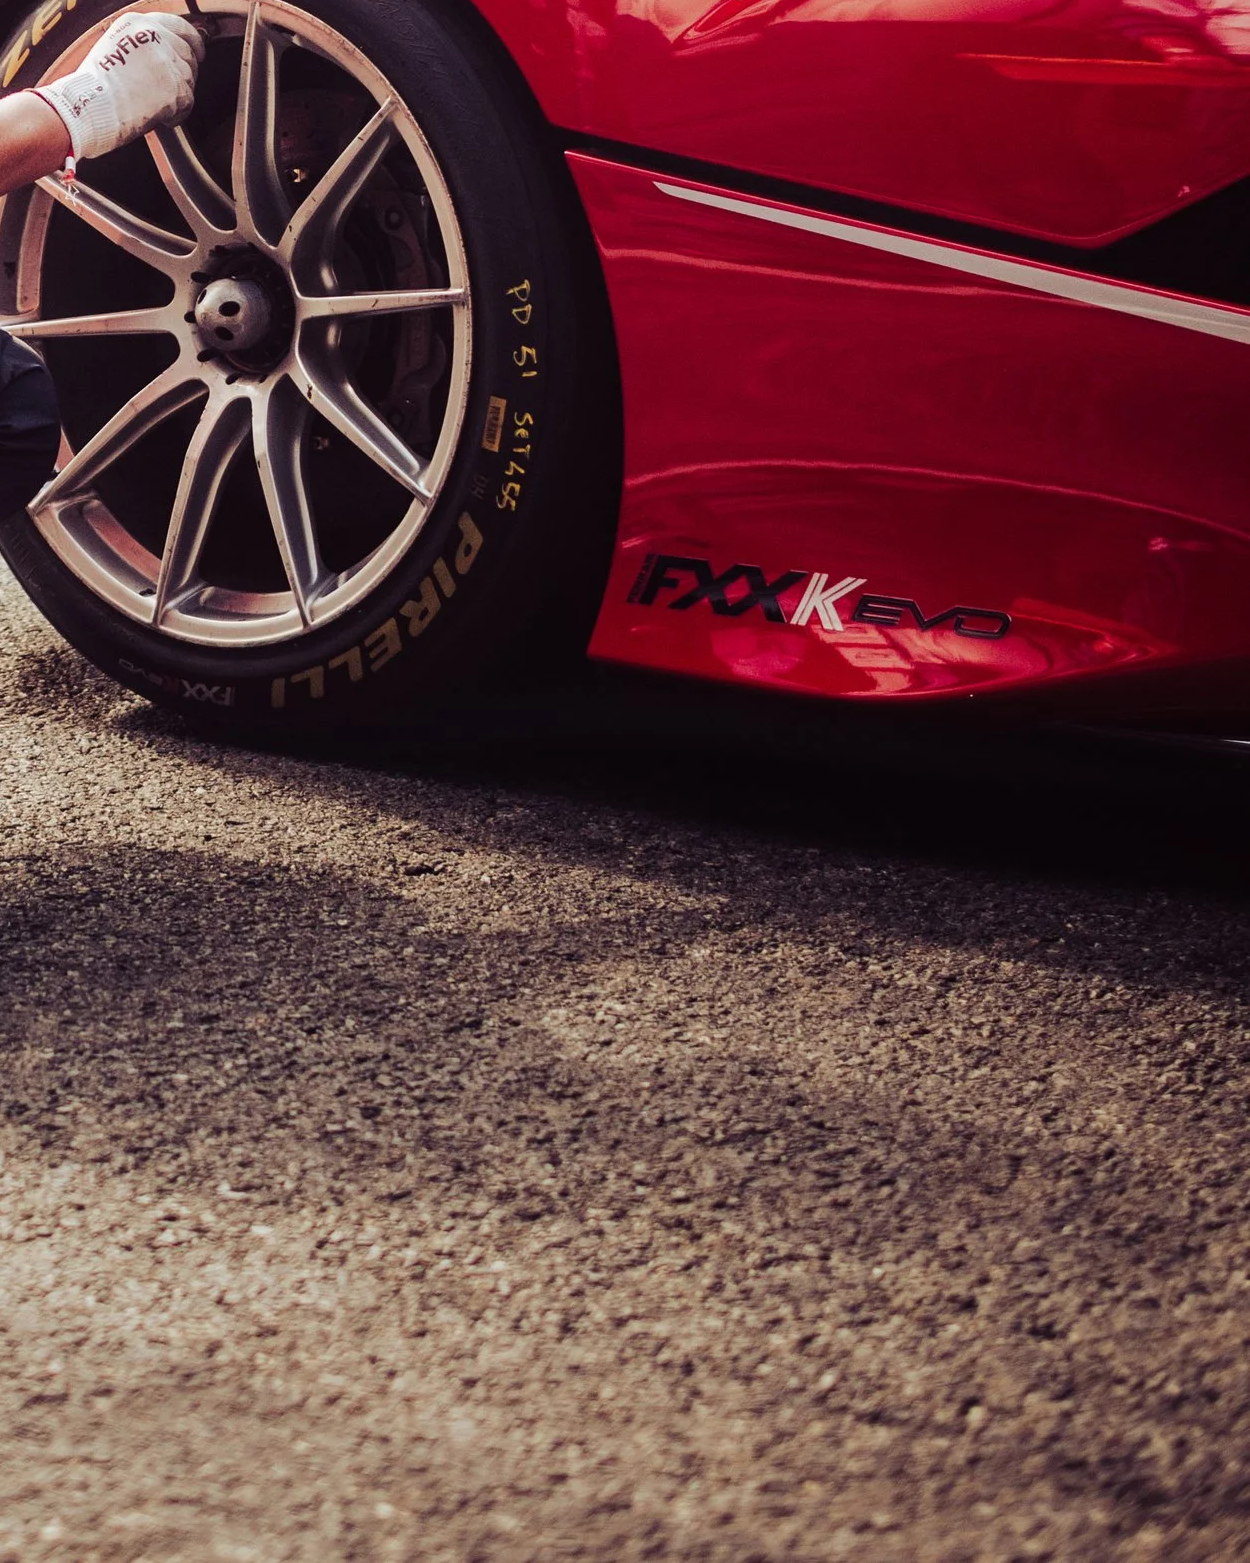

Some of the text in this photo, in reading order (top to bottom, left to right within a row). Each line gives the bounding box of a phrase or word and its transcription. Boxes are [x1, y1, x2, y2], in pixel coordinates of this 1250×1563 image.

[99, 29, 161, 72] HyFlex
[506, 279, 533, 325] PD
[270, 511, 484, 709] PIRELLI
[852, 592, 1012, 639] EVO
